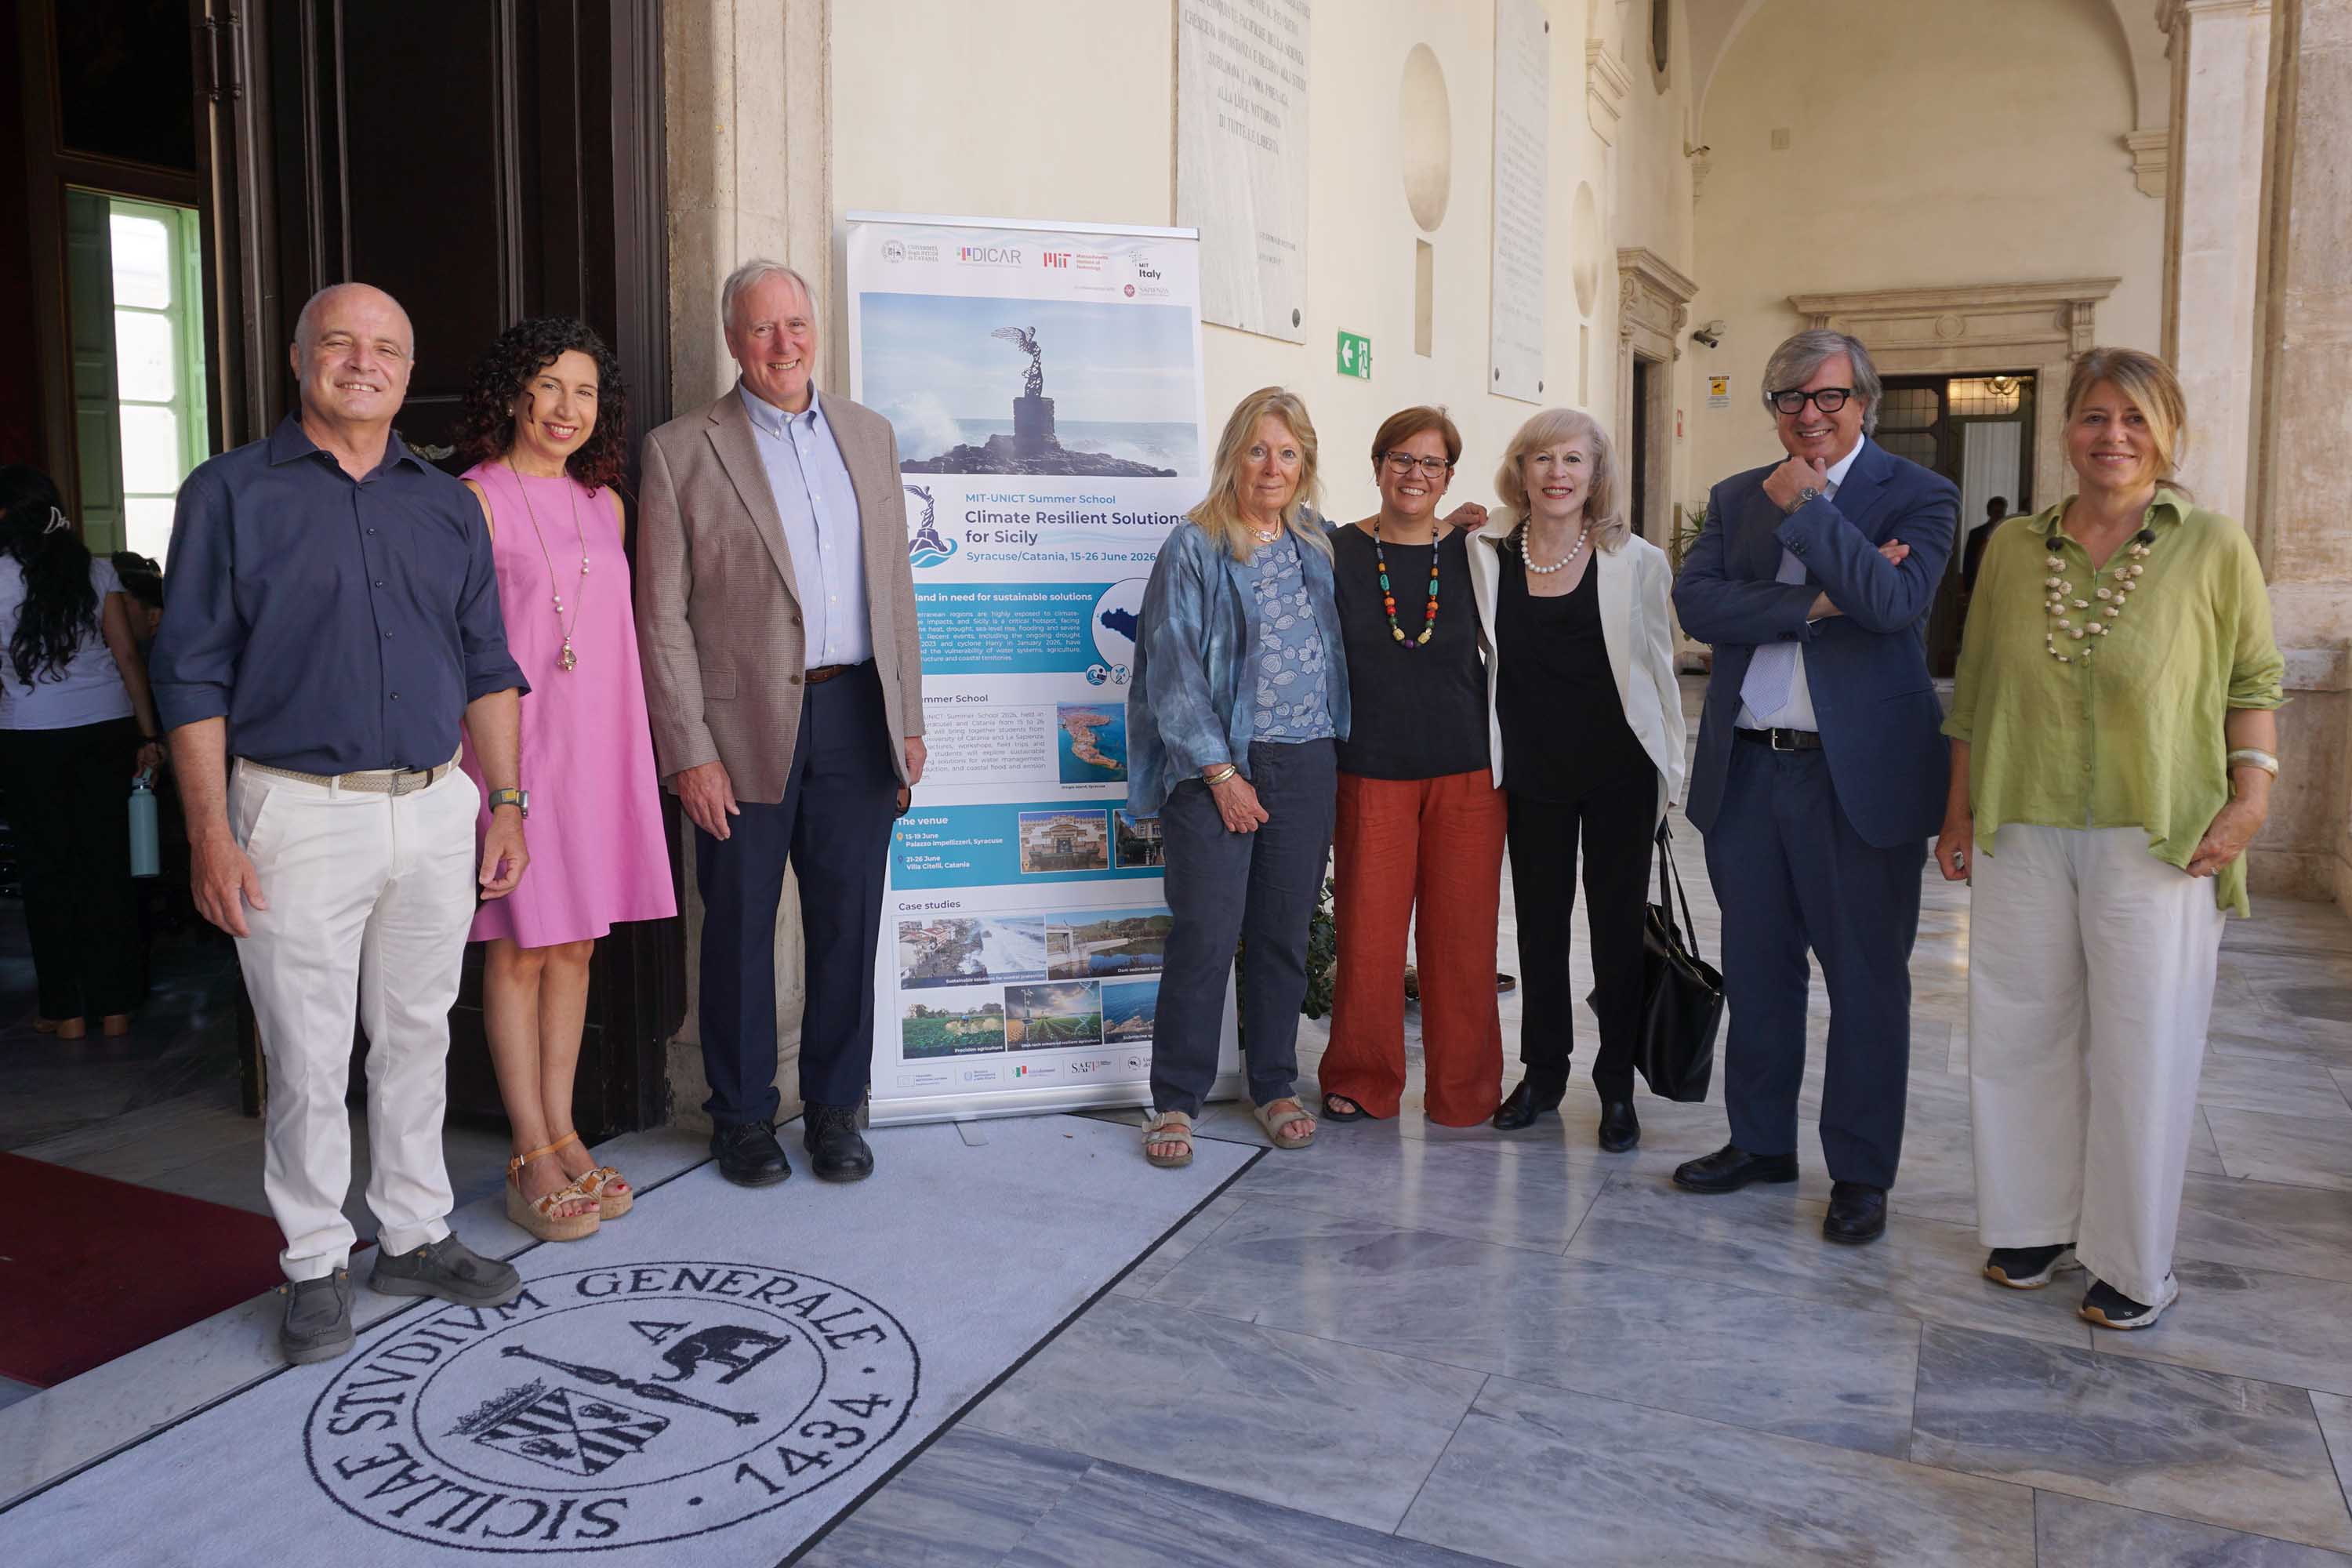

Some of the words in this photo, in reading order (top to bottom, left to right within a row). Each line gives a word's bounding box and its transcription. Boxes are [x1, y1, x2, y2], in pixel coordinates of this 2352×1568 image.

[972, 248, 1022, 264] DICAR
[1139, 269, 1161, 280] Italy
[965, 494, 1025, 503] MIT-UNICT
[1029, 494, 1076, 504] Summer
[1079, 495, 1116, 504] School
[965, 510, 1031, 524] Climate
[1036, 510, 1107, 524] Resilient
[966, 530, 990, 543] for
[994, 530, 1038, 546] Sicily
[966, 551, 1068, 563] Syracuse/Catania,
[1071, 552, 1098, 561] 15-26
[1100, 552, 1127, 561] June
[1130, 552, 1156, 561] 2026
[915, 593, 936, 601] land
[938, 593, 948, 601] in
[950, 593, 975, 601] need
[977, 593, 991, 601] for
[993, 592, 1047, 601] sustainable
[1049, 592, 1093, 601] solutions
[956, 694, 988, 702] School
[897, 817, 916, 826] The
[973, 838, 1003, 846] Syracuse
[925, 900, 961, 909] studies
[576, 1267, 887, 1351] GENERALE
[735, 1392, 892, 1496] 1434
